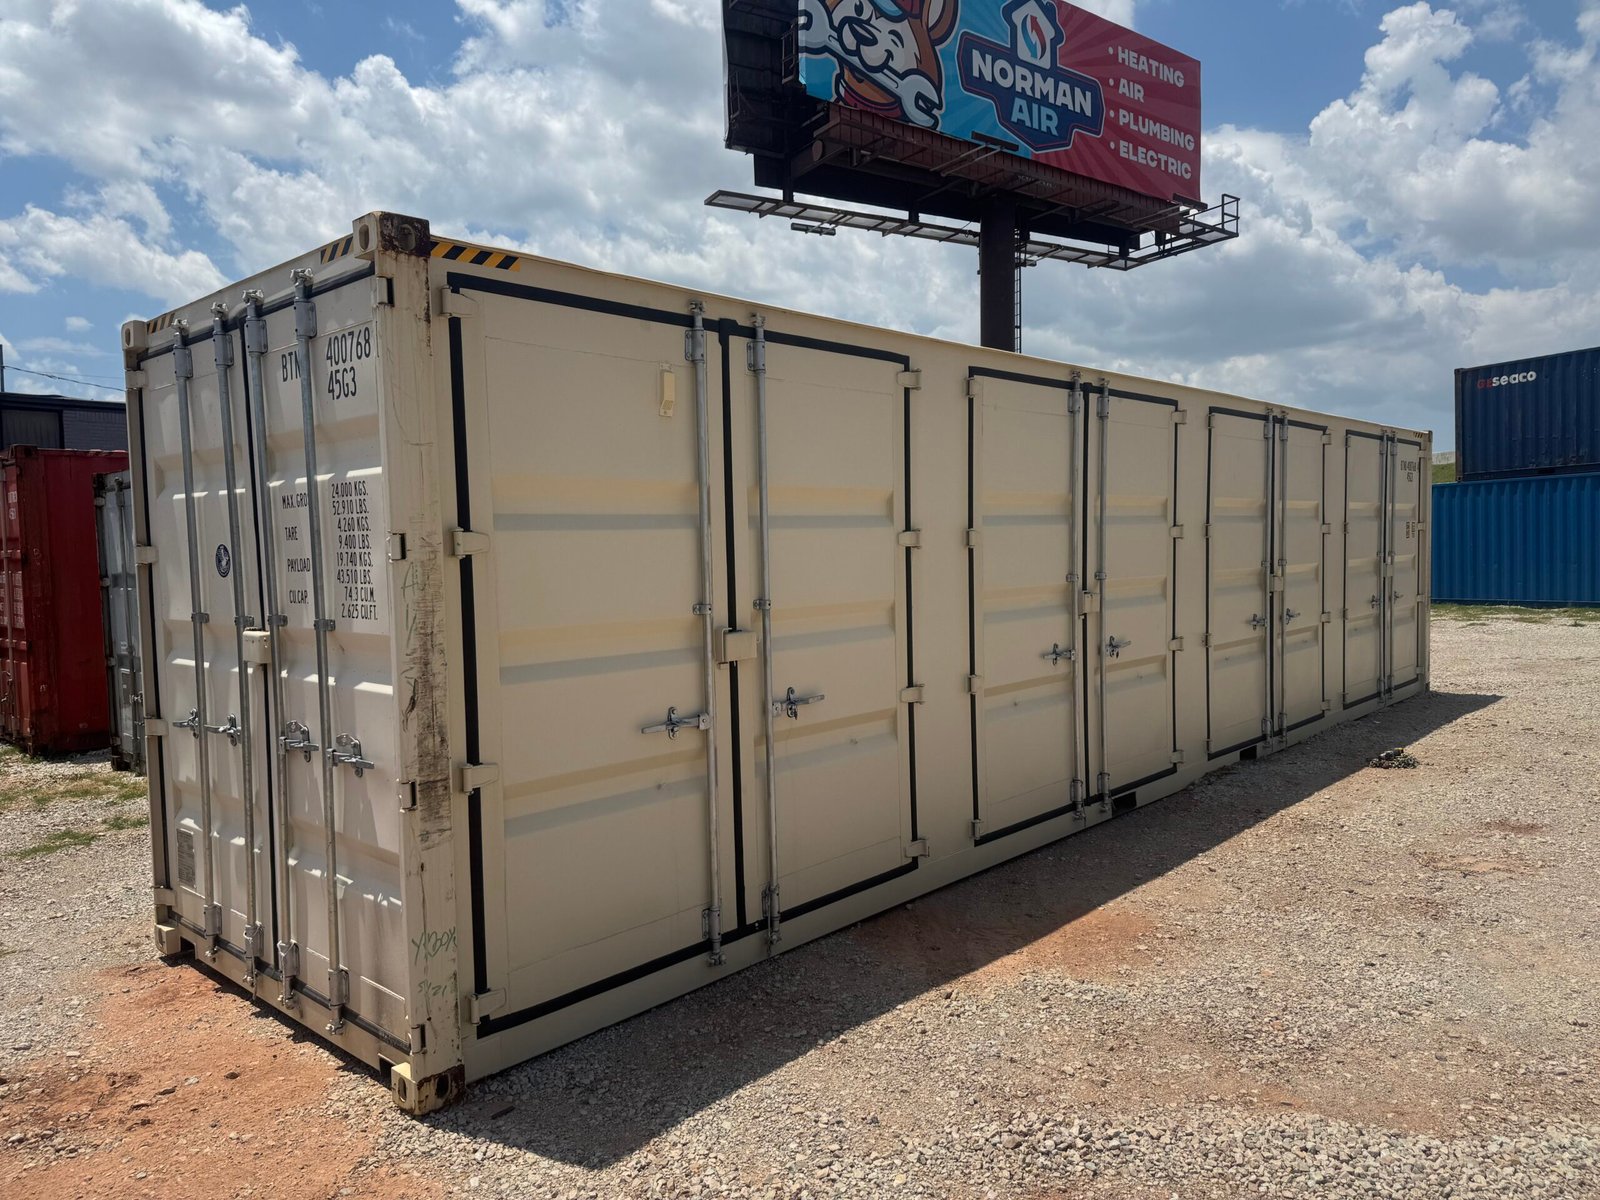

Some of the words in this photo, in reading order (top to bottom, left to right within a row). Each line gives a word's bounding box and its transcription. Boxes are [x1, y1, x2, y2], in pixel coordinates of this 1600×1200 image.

[1118, 46, 1185, 88] HEATING
[972, 49, 1092, 117] NORMAN
[1118, 78, 1144, 103] AIR
[1011, 97, 1059, 137] AIR
[1119, 109, 1195, 151] PLUMBING
[1119, 140, 1192, 180] ELECTRIC
[281, 351, 302, 382] BTN
[326, 327, 371, 366] 400768
[328, 366, 357, 400] 45G3
[354, 480, 369, 496] KGS.
[355, 498, 369, 514] LBS.
[285, 526, 298, 540] TARE
[356, 516, 371, 532] KGS.
[358, 533, 371, 549] LBS.
[287, 558, 311, 572] PAYLOAD
[359, 551, 373, 567] KGS.
[360, 569, 373, 585] LBS.
